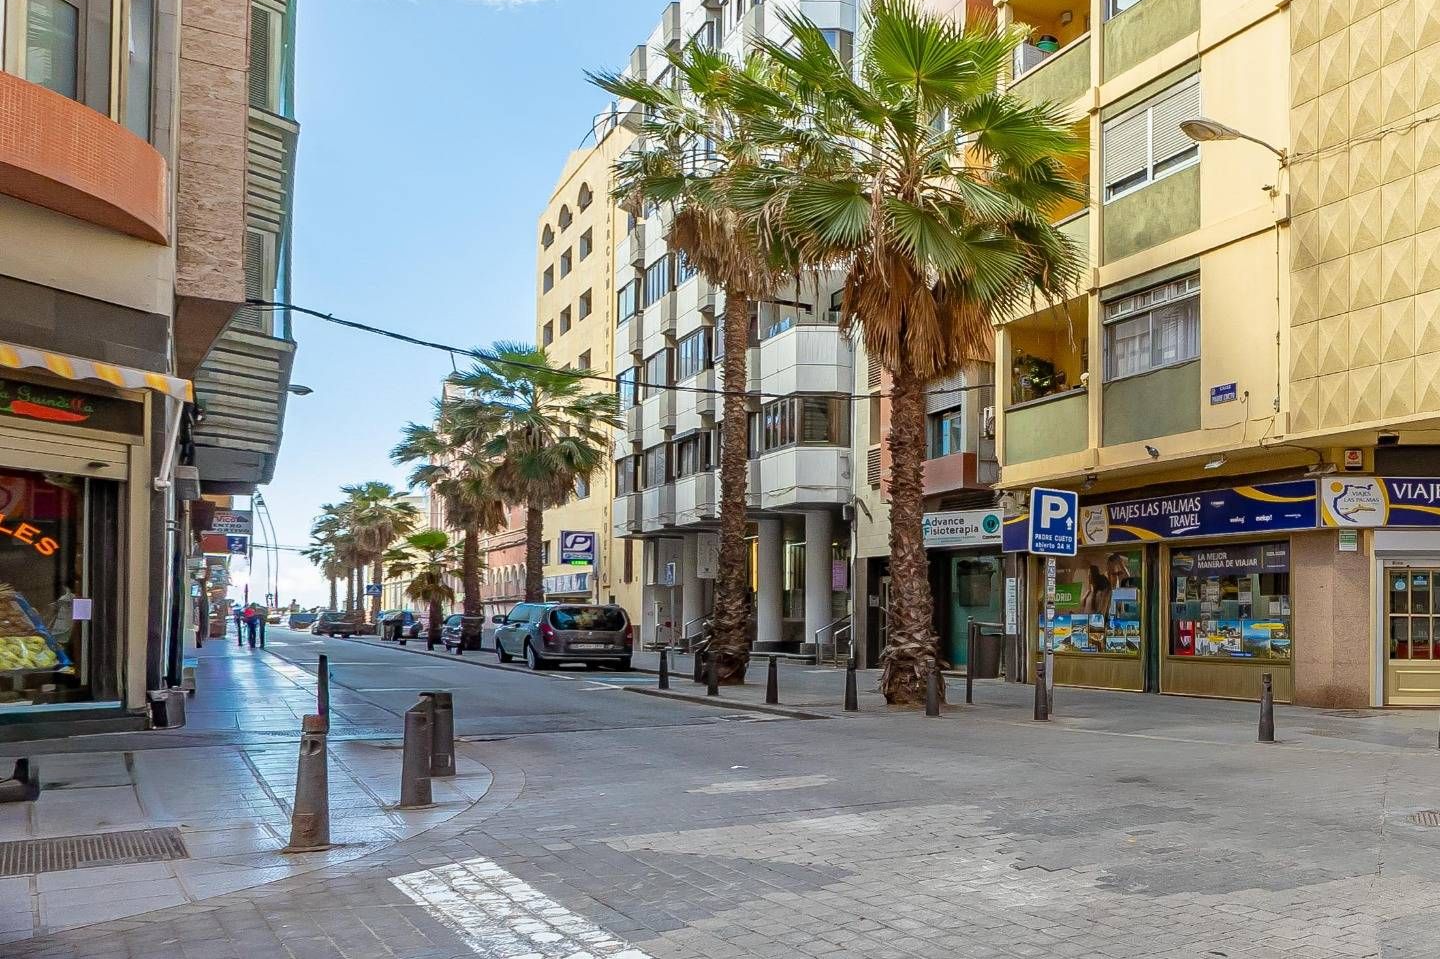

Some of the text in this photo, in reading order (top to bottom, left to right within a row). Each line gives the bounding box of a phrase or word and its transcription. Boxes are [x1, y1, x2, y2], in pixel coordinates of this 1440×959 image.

[1041, 495, 1068, 528] P
[1110, 504, 1140, 523] VIAJES
[1141, 502, 1160, 517] LAS
[1161, 497, 1201, 515] PALMAS
[924, 517, 964, 527] Advance
[1169, 513, 1200, 528] TRAVEL
[924, 525, 979, 536] Fisioterapia
[1197, 552, 1228, 561] LA MEJOR
[1198, 559, 1224, 568] MANERA
[1225, 559, 1233, 568] DE
[1235, 558, 1258, 567] VIAJAR
